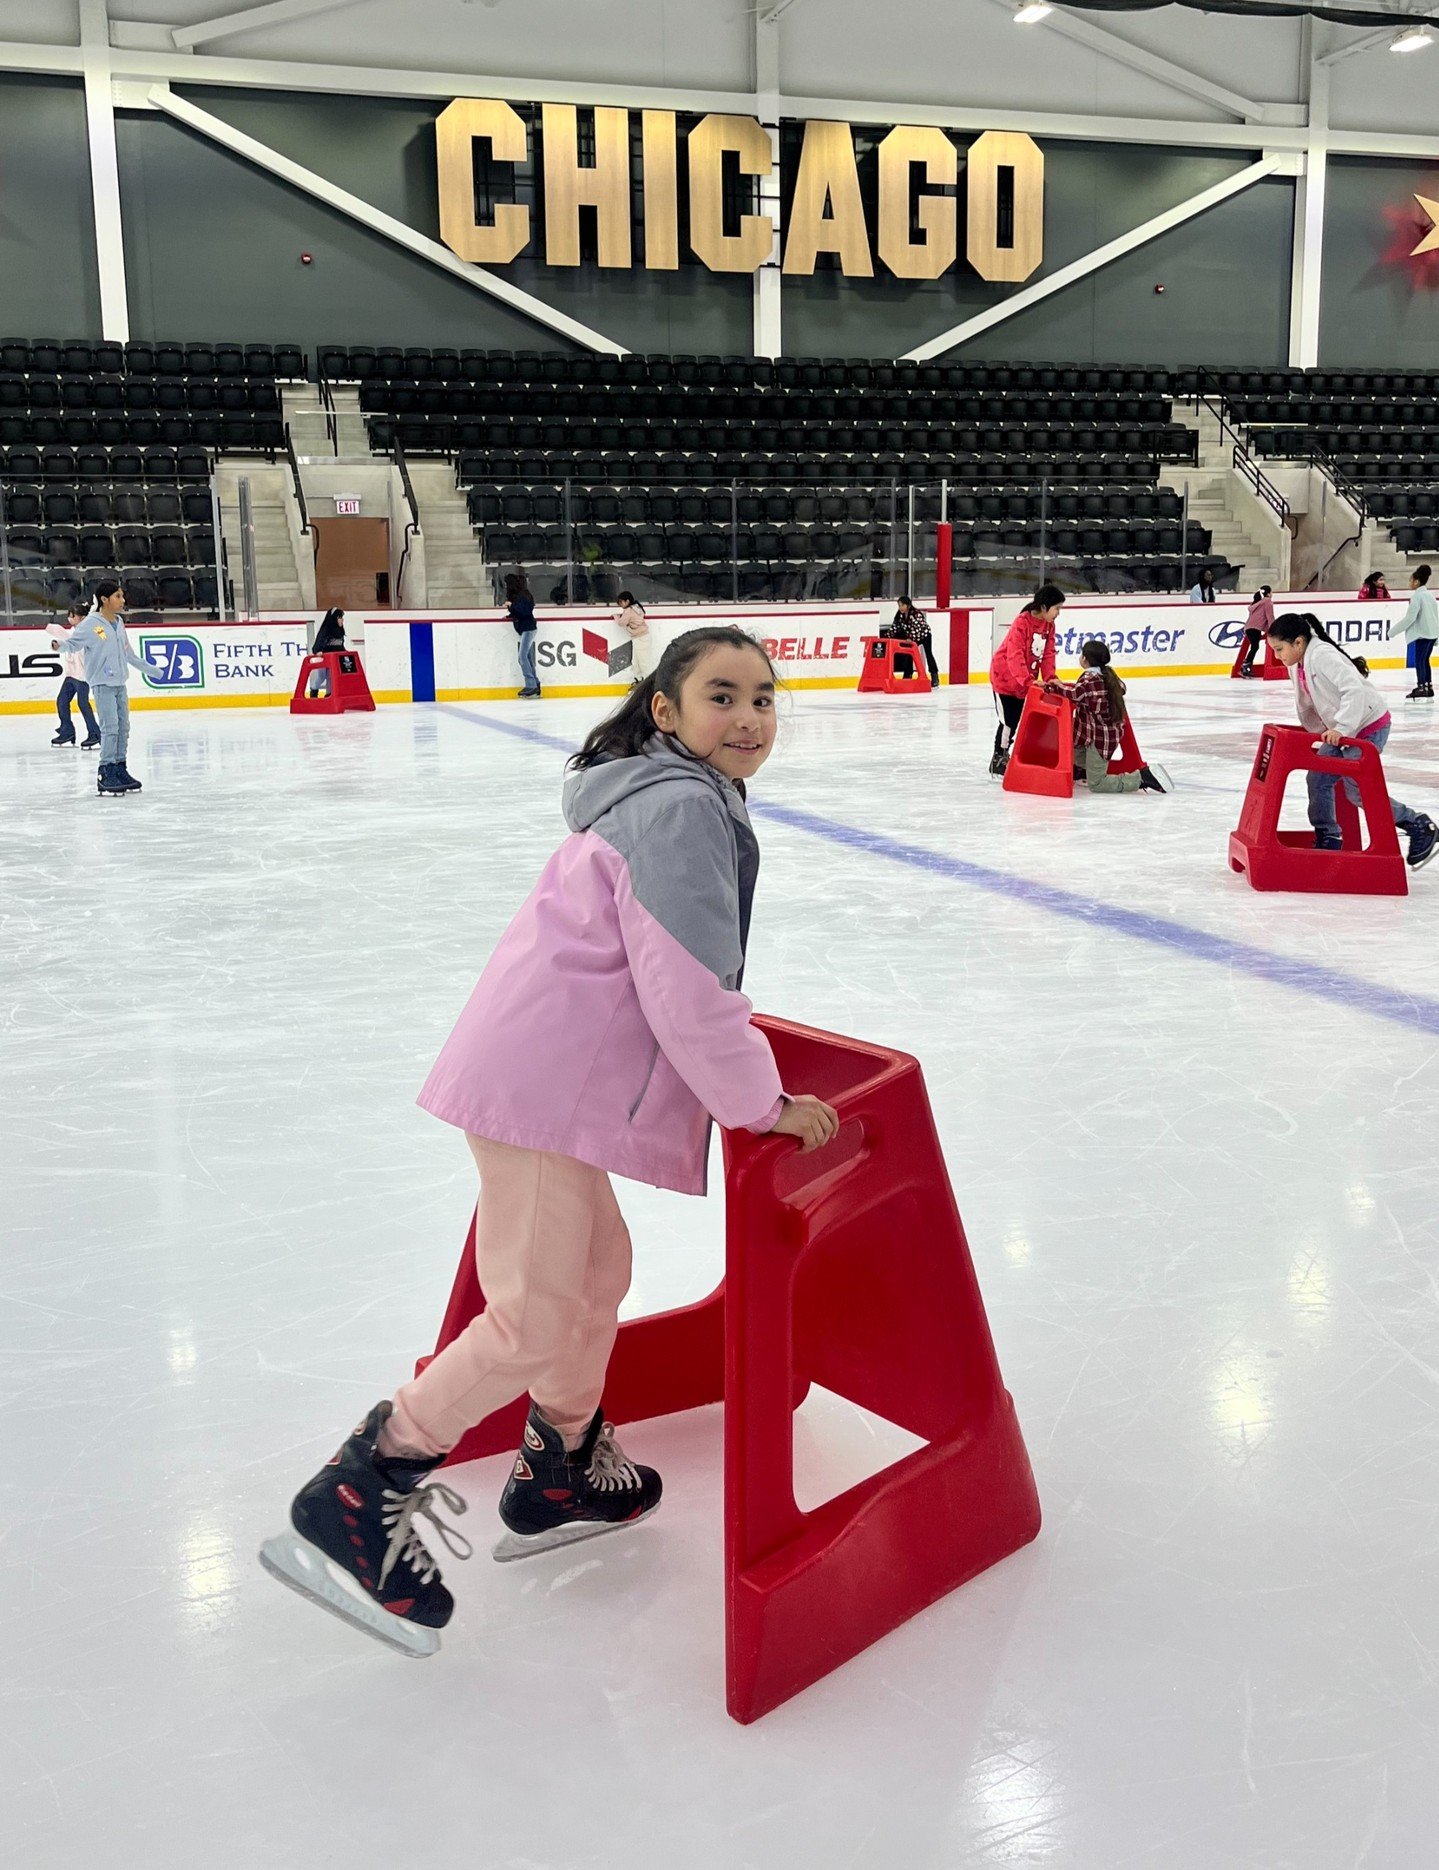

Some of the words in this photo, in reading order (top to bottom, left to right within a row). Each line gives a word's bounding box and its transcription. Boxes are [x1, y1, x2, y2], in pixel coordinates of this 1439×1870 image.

[436, 98, 1045, 283] CHICAGO
[338, 501, 357, 513] EXIT
[213, 643, 272, 658] FIFTH
[518, 640, 577, 667] SG
[761, 636, 850, 660] BELLE
[214, 664, 274, 678] BANK
